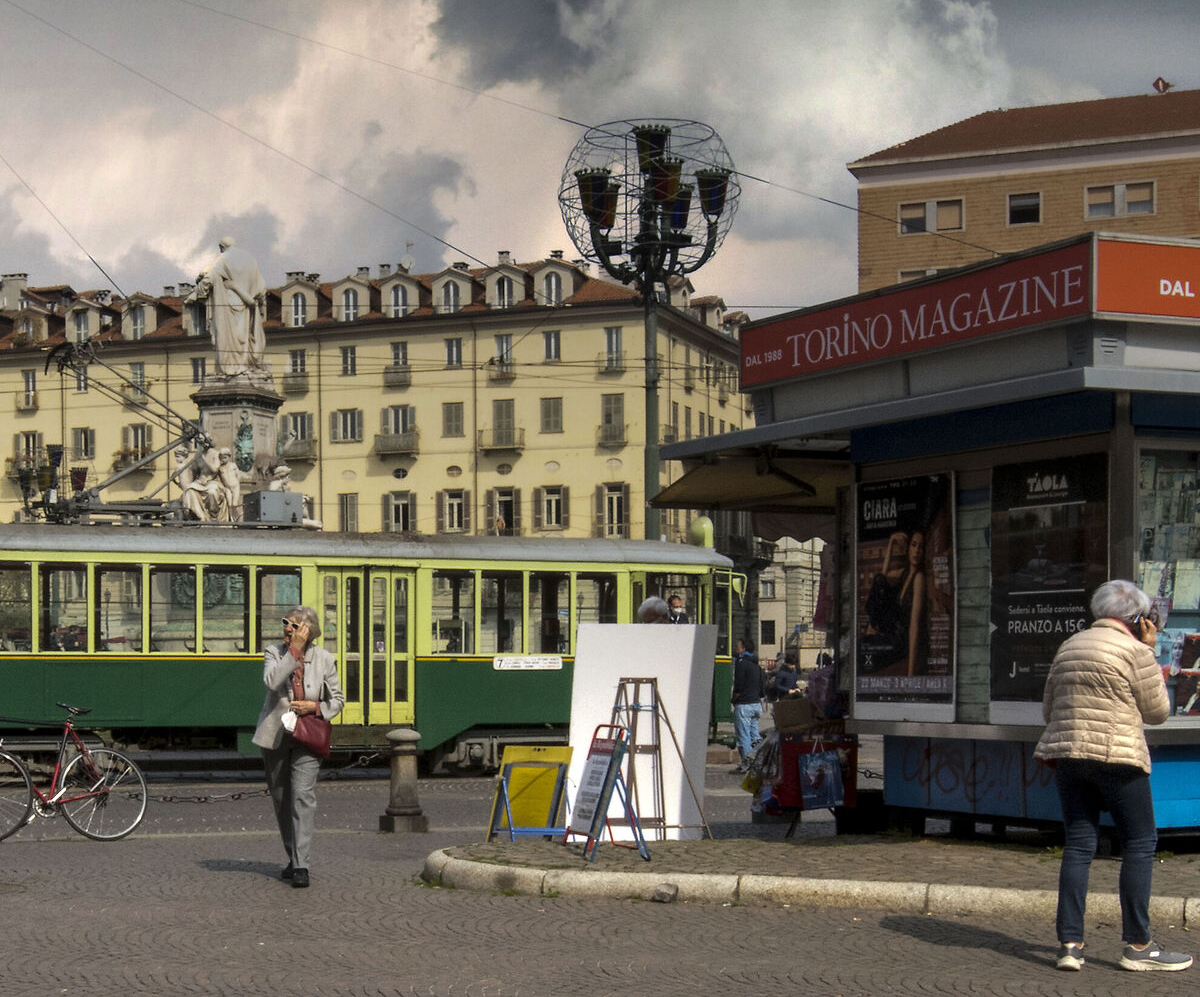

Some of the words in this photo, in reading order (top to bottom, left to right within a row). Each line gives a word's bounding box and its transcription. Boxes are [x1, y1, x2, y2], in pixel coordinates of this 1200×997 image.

[1159, 279, 1195, 298] DAL
[745, 354, 762, 368] DAL
[764, 349, 782, 364] 1988
[899, 265, 1085, 345] MAGAZINE
[863, 496, 898, 521] CIARA
[1008, 619, 1052, 634] PRANZO
[1055, 619, 1062, 633] A
